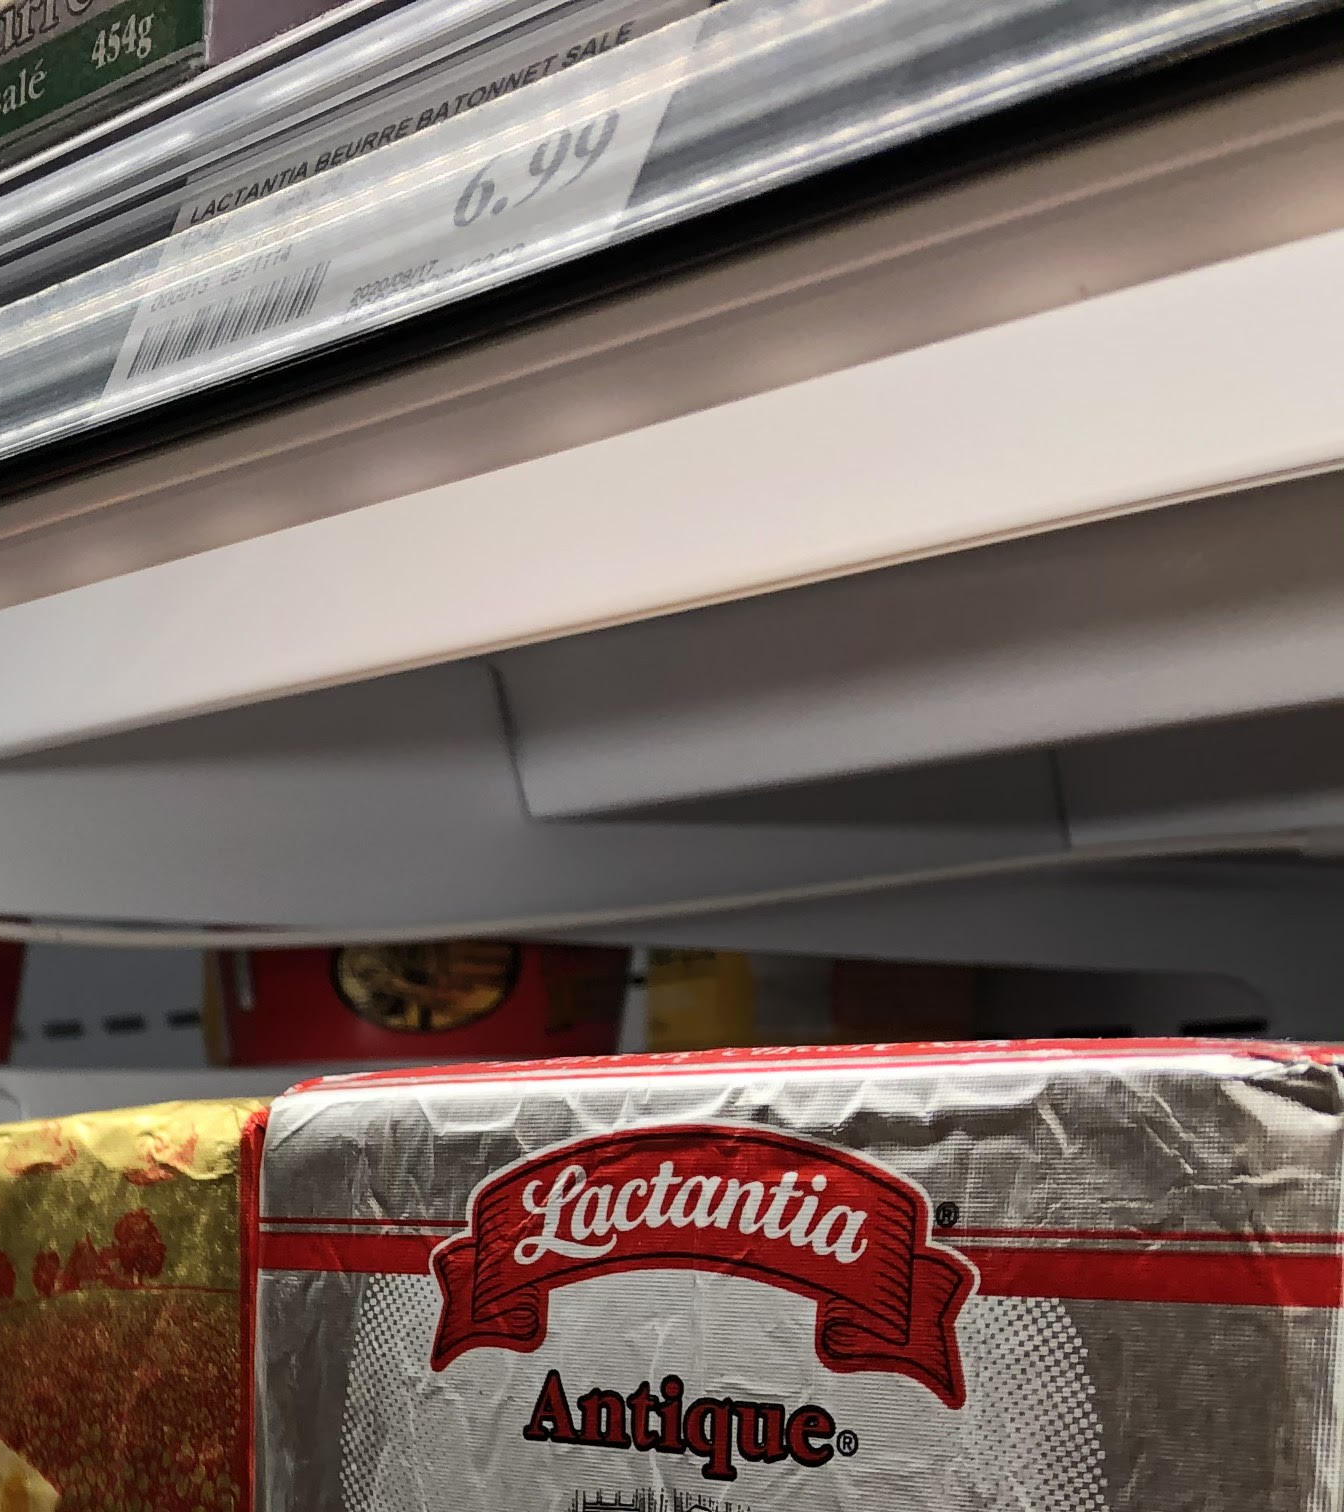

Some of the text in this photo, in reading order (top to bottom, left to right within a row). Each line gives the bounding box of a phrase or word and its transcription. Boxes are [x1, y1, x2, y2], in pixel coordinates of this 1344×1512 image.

[91, 12, 155, 70] 454g
[190, 160, 307, 225] LACTANTIA
[315, 116, 413, 177] BEURRE
[415, 53, 560, 132] BATONNET
[561, 20, 636, 69] SALE
[452, 108, 621, 228] 6.99
[512, 1160, 869, 1267] Lactantia
[522, 1368, 837, 1482] Antique
